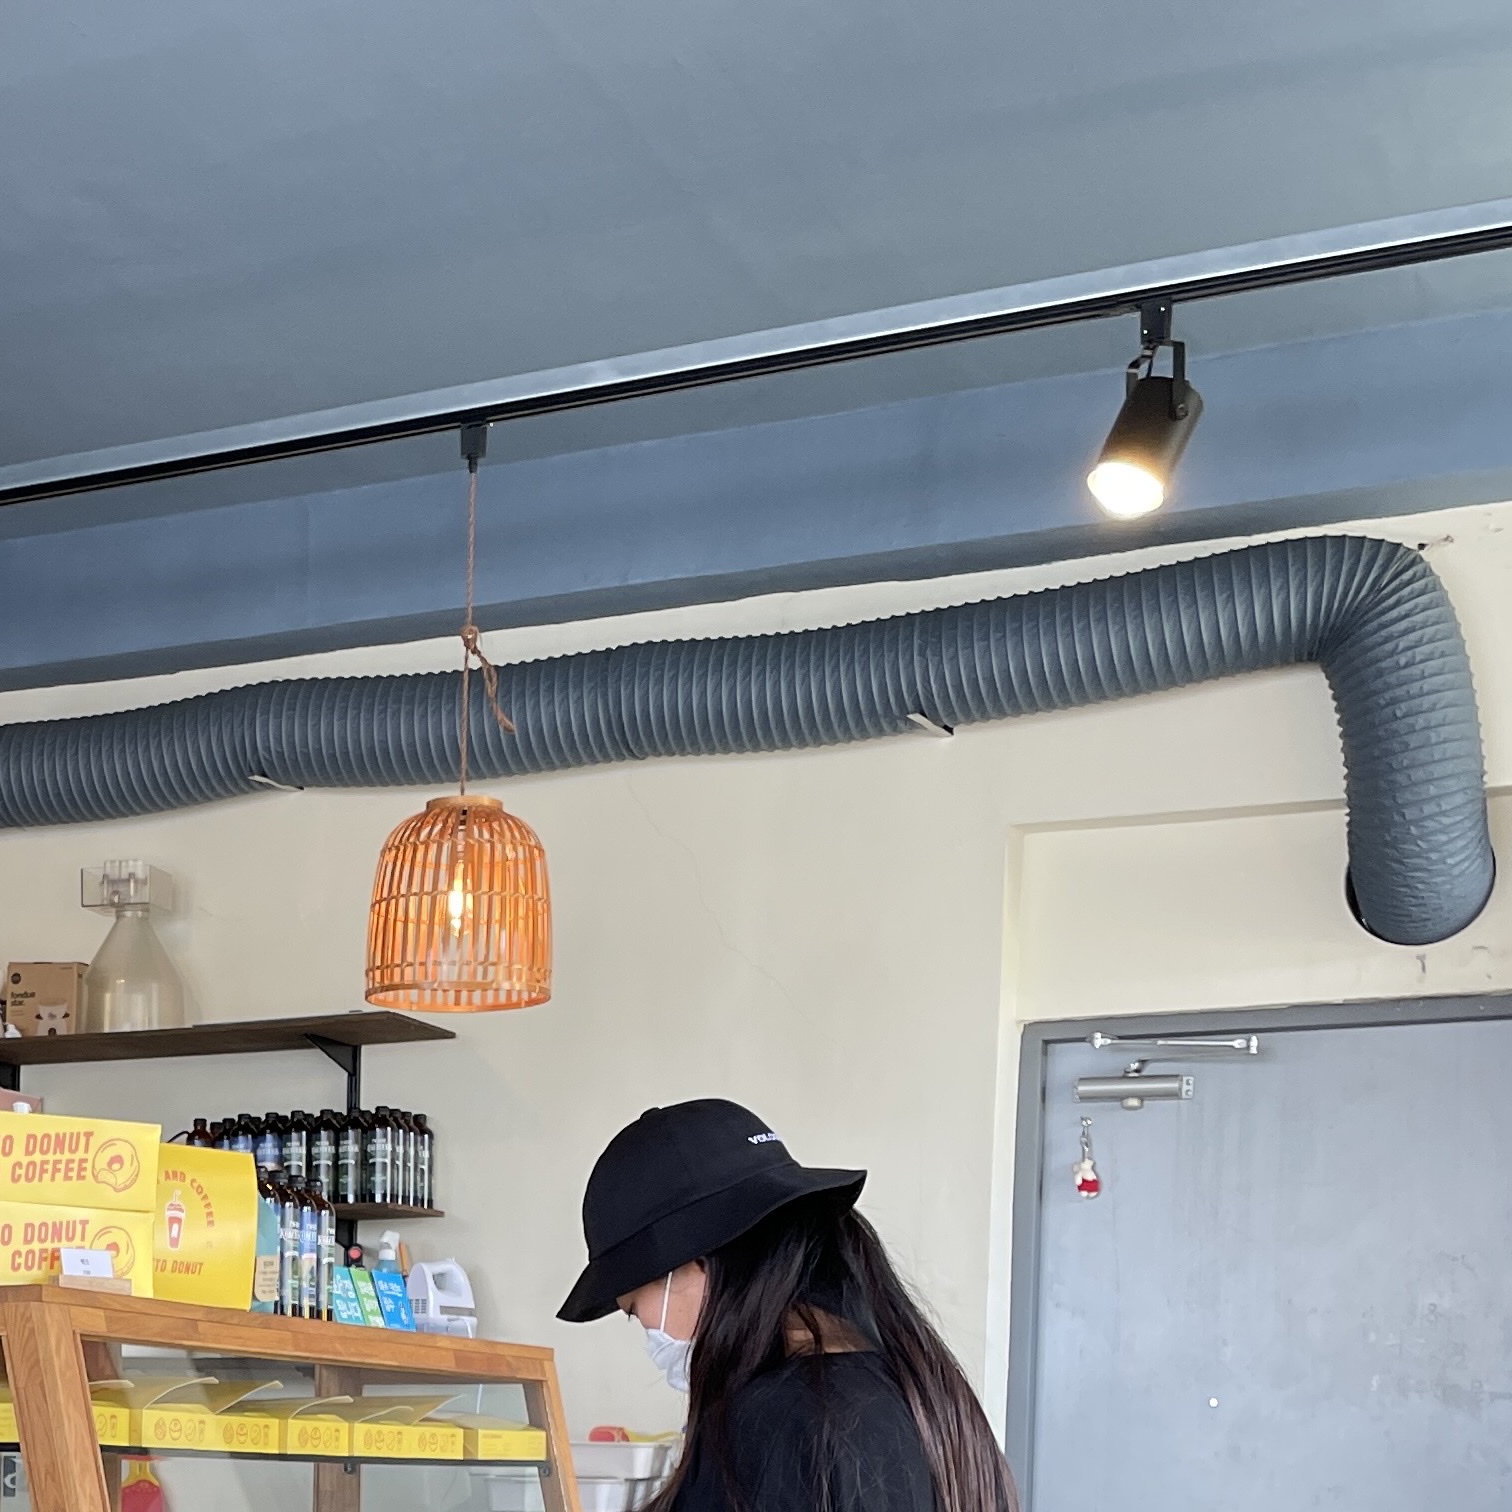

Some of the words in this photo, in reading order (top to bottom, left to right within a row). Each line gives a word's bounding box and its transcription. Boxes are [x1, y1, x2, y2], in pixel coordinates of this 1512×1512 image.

[24, 1131, 95, 1157] DONUT
[10, 1157, 89, 1184] COFFEE
[164, 1169, 186, 1183] AND
[189, 1177, 215, 1228] COFFEE
[23, 1219, 90, 1245] DONUT
[10, 1247, 61, 1273] COFF
[170, 1260, 203, 1276] DONUT
